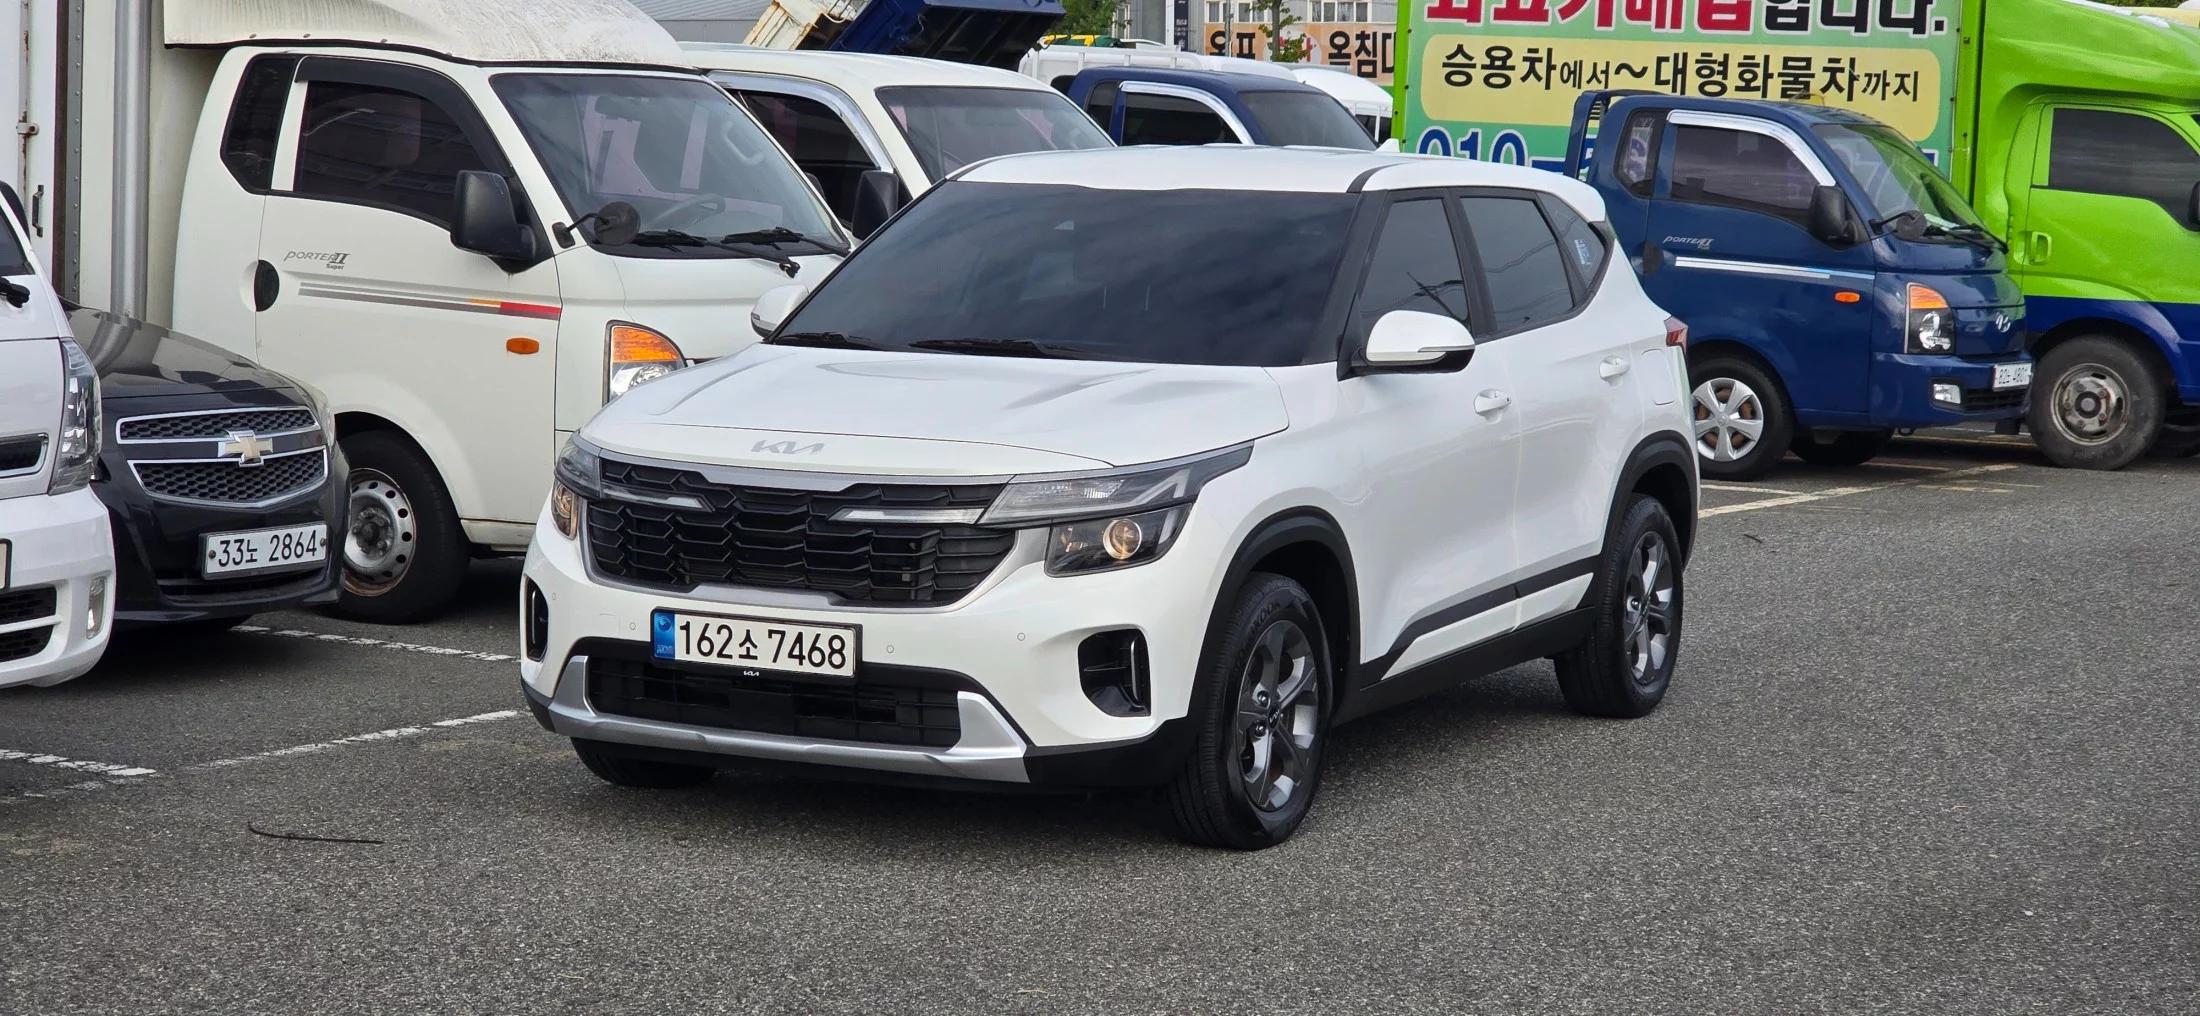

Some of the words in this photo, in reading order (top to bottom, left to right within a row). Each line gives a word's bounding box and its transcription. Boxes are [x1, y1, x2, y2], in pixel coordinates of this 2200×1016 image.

[218, 538, 258, 567] 33노
[268, 529, 318, 562] 2864
[679, 620, 758, 660] 162소
[767, 628, 846, 670] 7468
